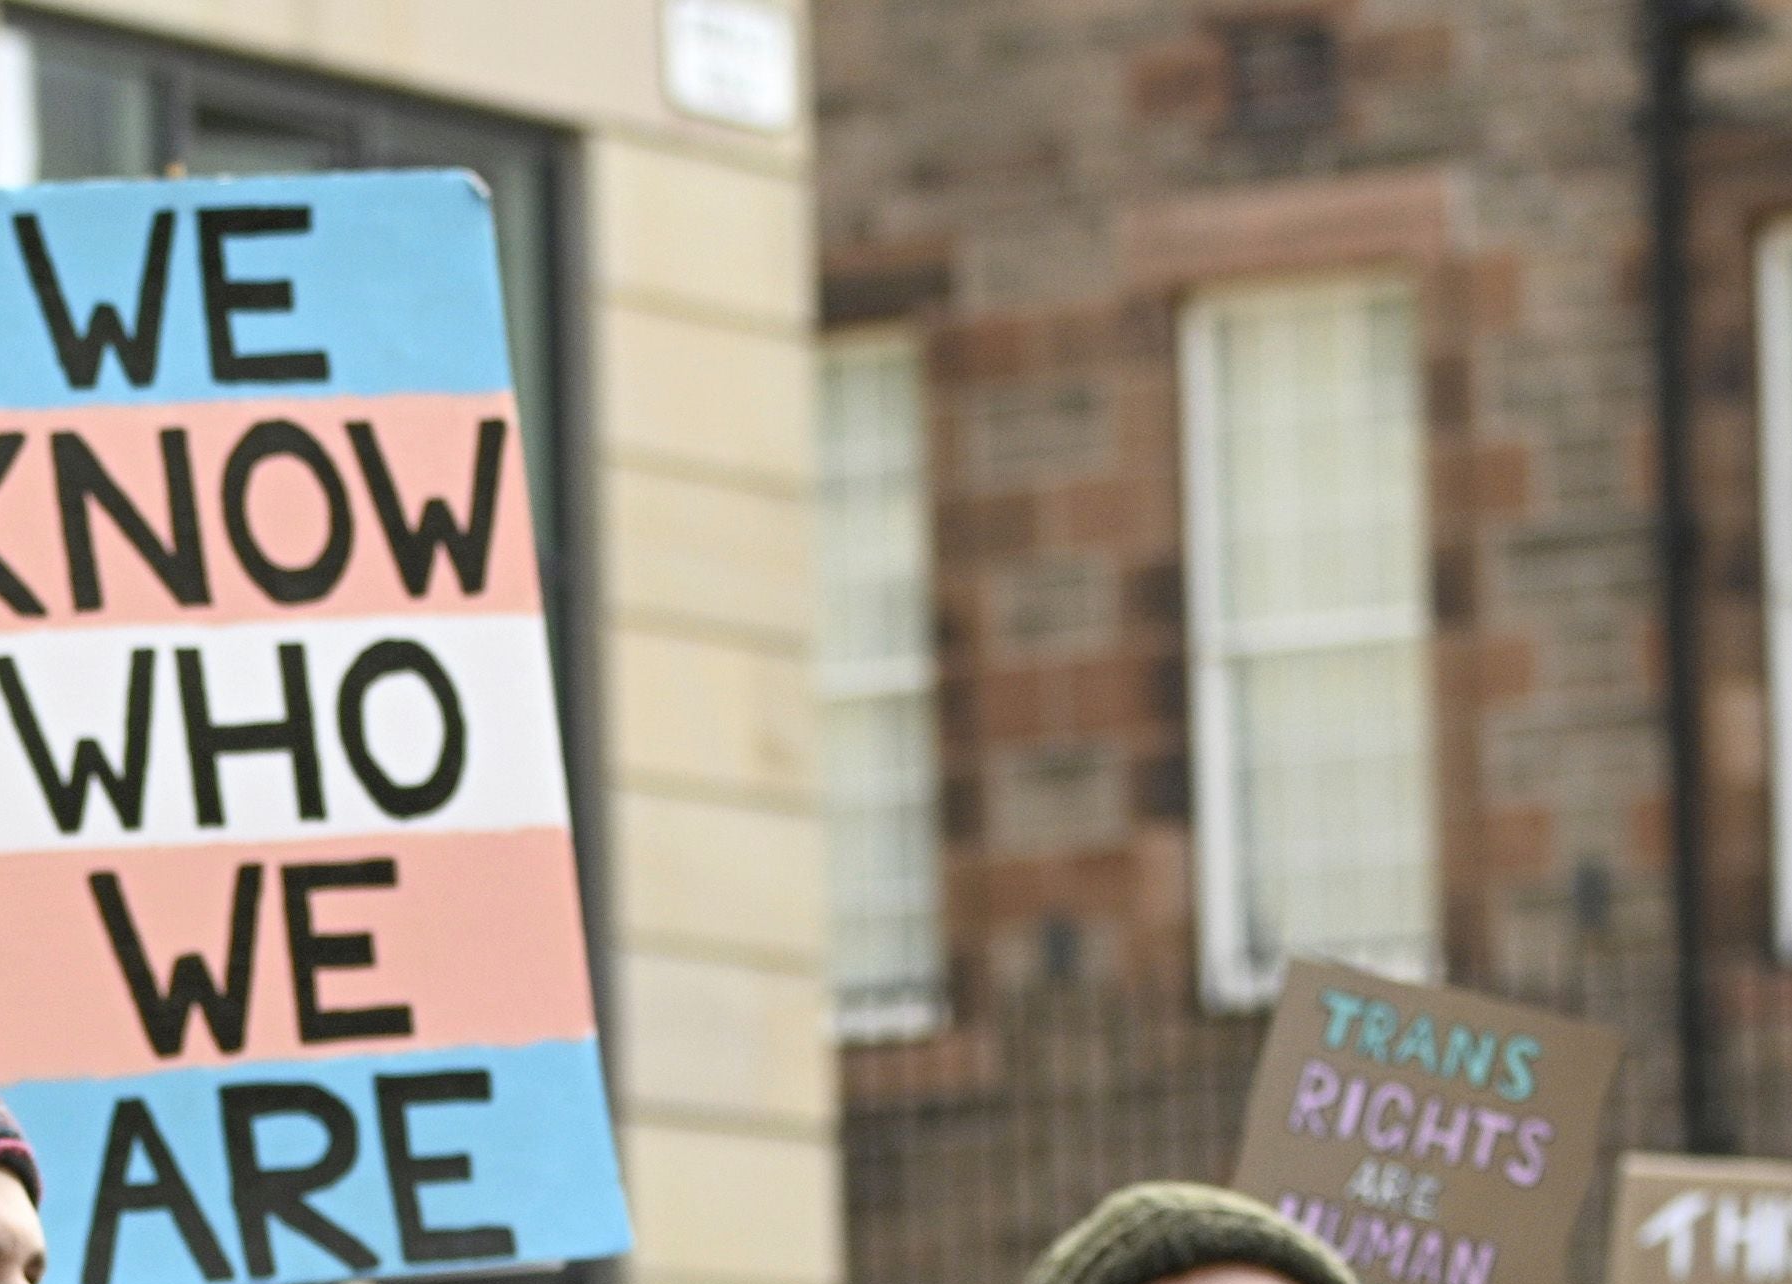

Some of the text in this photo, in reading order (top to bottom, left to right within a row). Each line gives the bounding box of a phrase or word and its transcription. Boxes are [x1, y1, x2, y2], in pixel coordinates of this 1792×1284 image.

[13, 204, 330, 389] WE
[87, 857, 413, 1058] WE
[1321, 988, 1544, 1101] TRANS
[1287, 1058, 1555, 1187] RIGHTS
[1348, 1157, 1441, 1221] ARE
